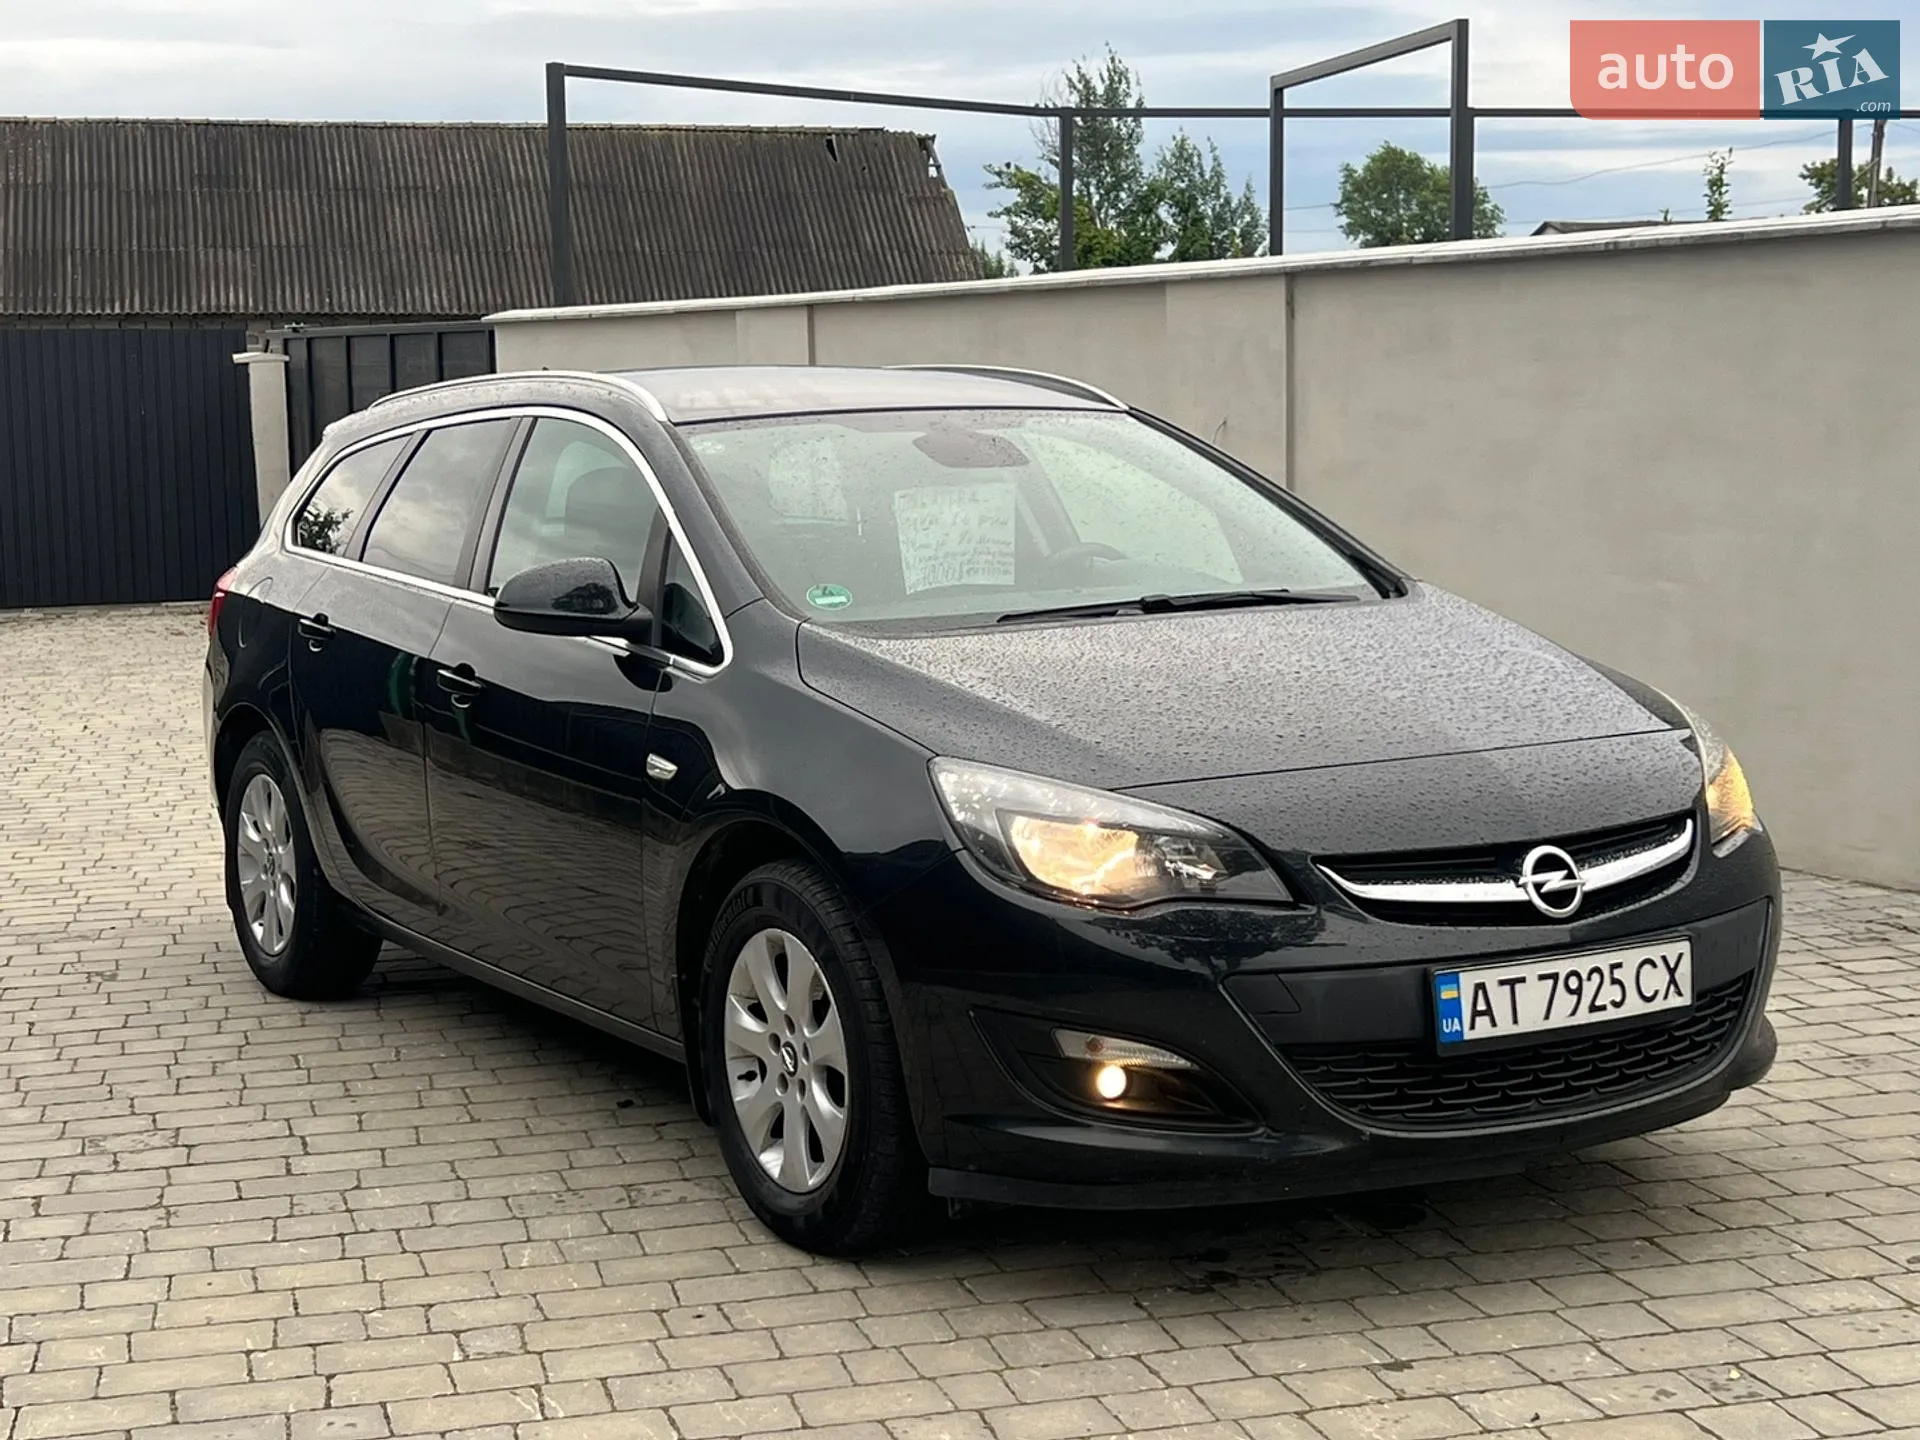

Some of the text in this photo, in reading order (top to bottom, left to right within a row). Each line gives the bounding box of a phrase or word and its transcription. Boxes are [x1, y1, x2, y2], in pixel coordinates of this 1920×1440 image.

[1469, 952, 1684, 1030] AT 7925 CX
[1443, 1018, 1461, 1032] UA
